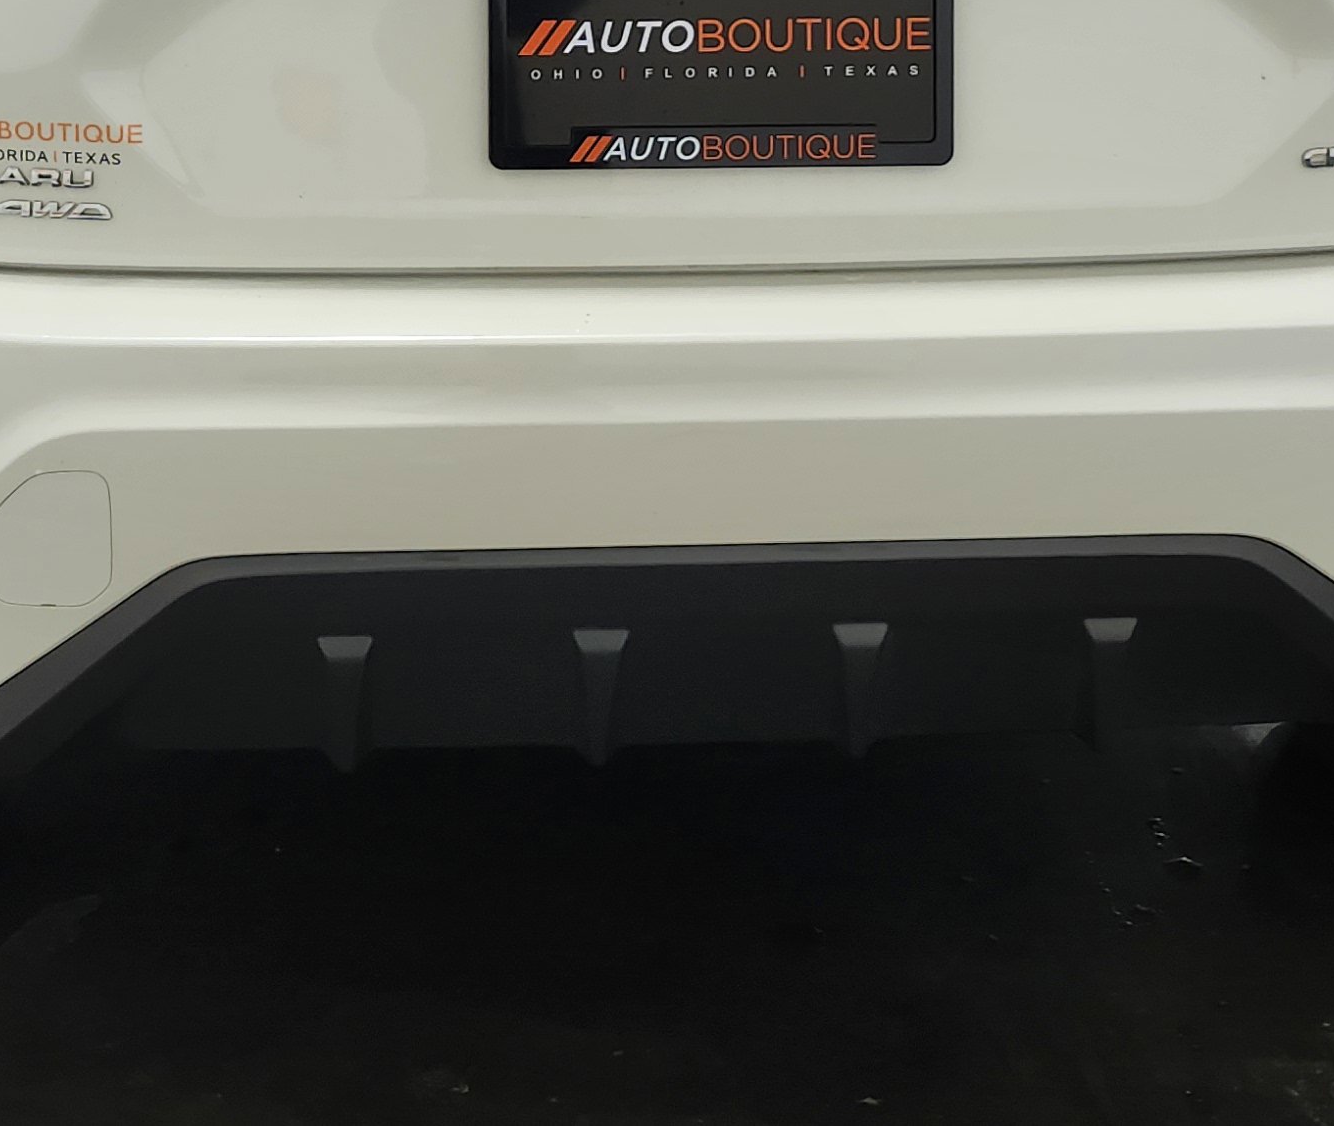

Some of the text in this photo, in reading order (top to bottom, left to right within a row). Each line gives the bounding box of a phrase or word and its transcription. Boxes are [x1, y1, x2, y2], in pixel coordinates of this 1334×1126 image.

[563, 16, 932, 55] AUTOBOUTIQUE
[529, 64, 919, 80] OHIO FLORIDA TEXAS
[62, 150, 122, 165] TEXAS
[603, 133, 877, 162] AUTOBOUTIQUE
